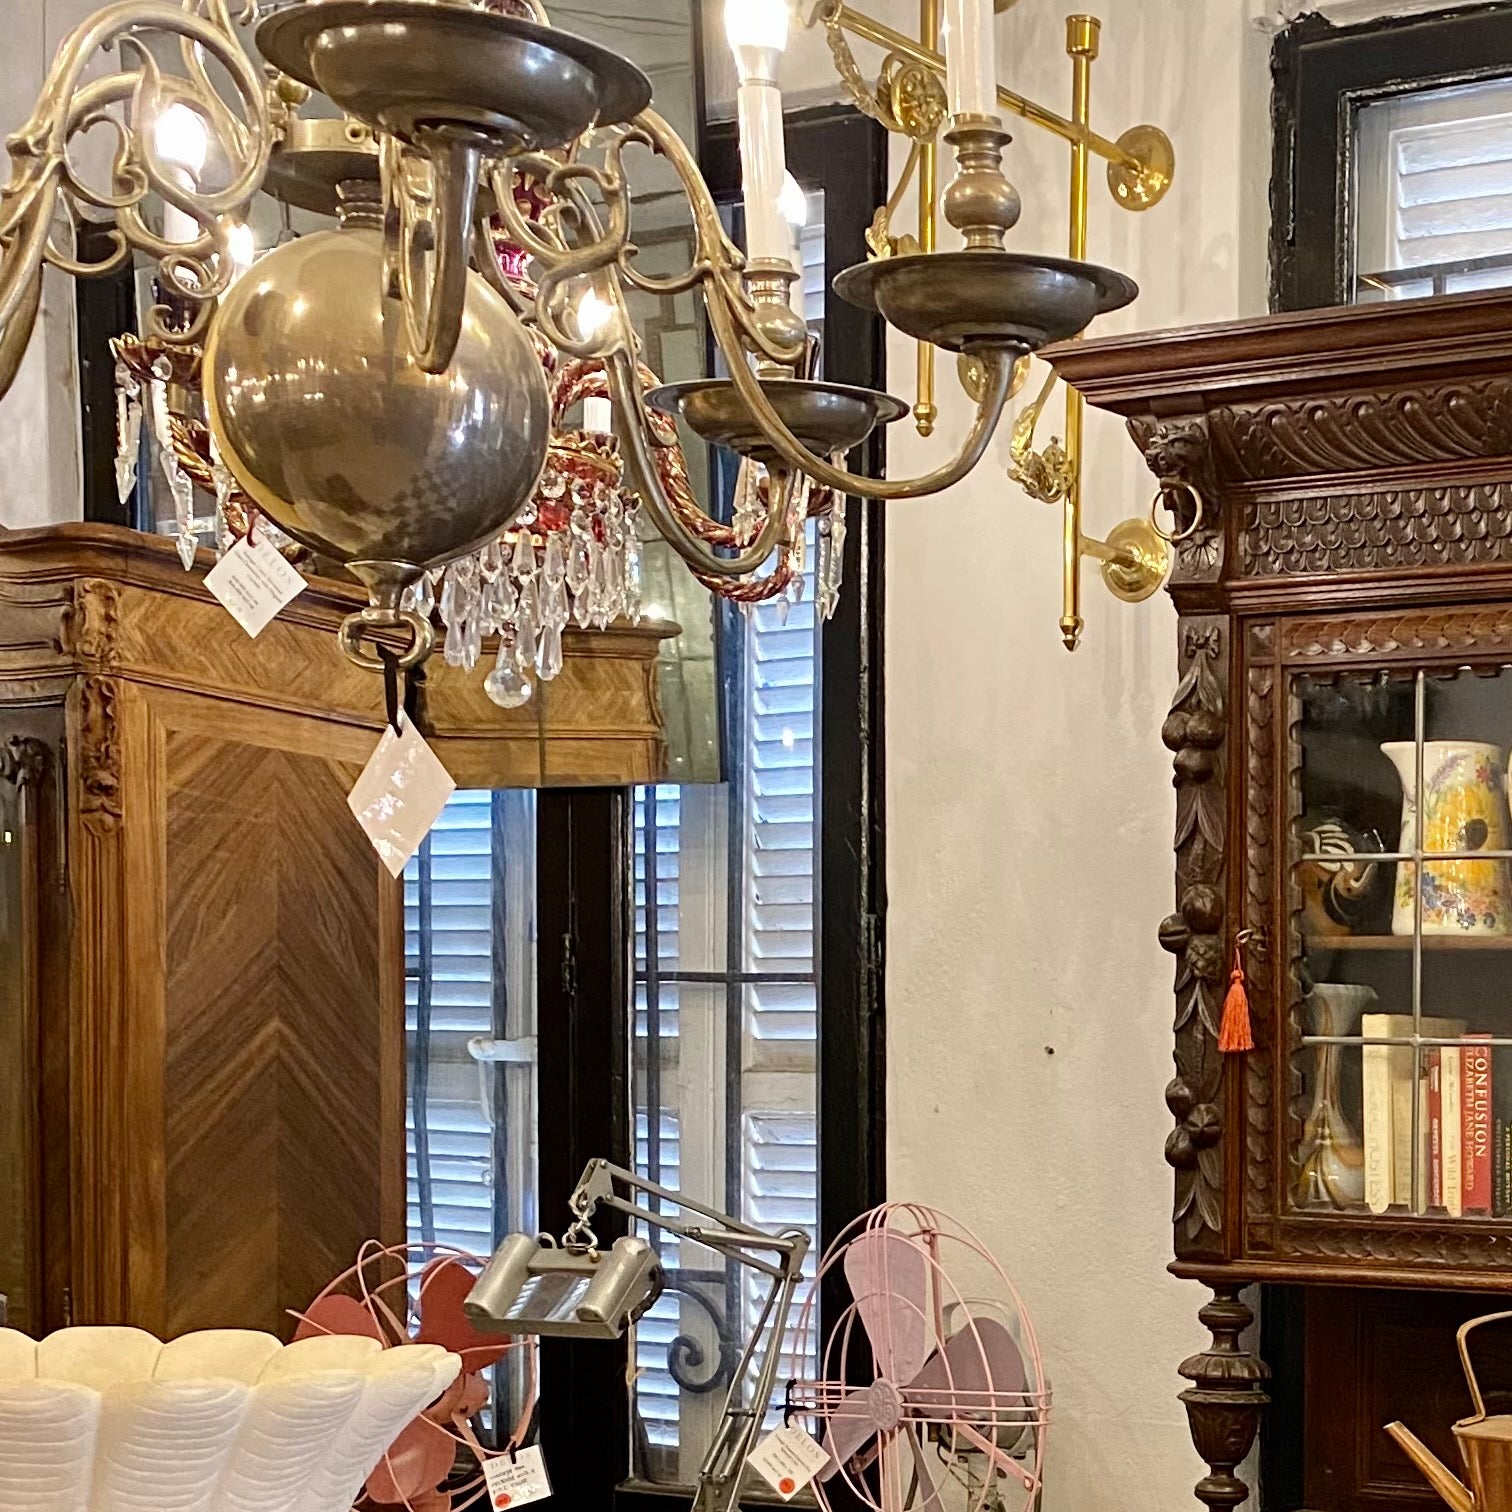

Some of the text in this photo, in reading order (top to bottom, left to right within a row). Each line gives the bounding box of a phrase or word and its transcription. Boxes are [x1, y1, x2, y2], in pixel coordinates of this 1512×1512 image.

[1464, 1110, 1473, 1137] JANE
[1474, 1046, 1486, 1157] CONFUSION
[1464, 1141, 1473, 1190] HOWARD
